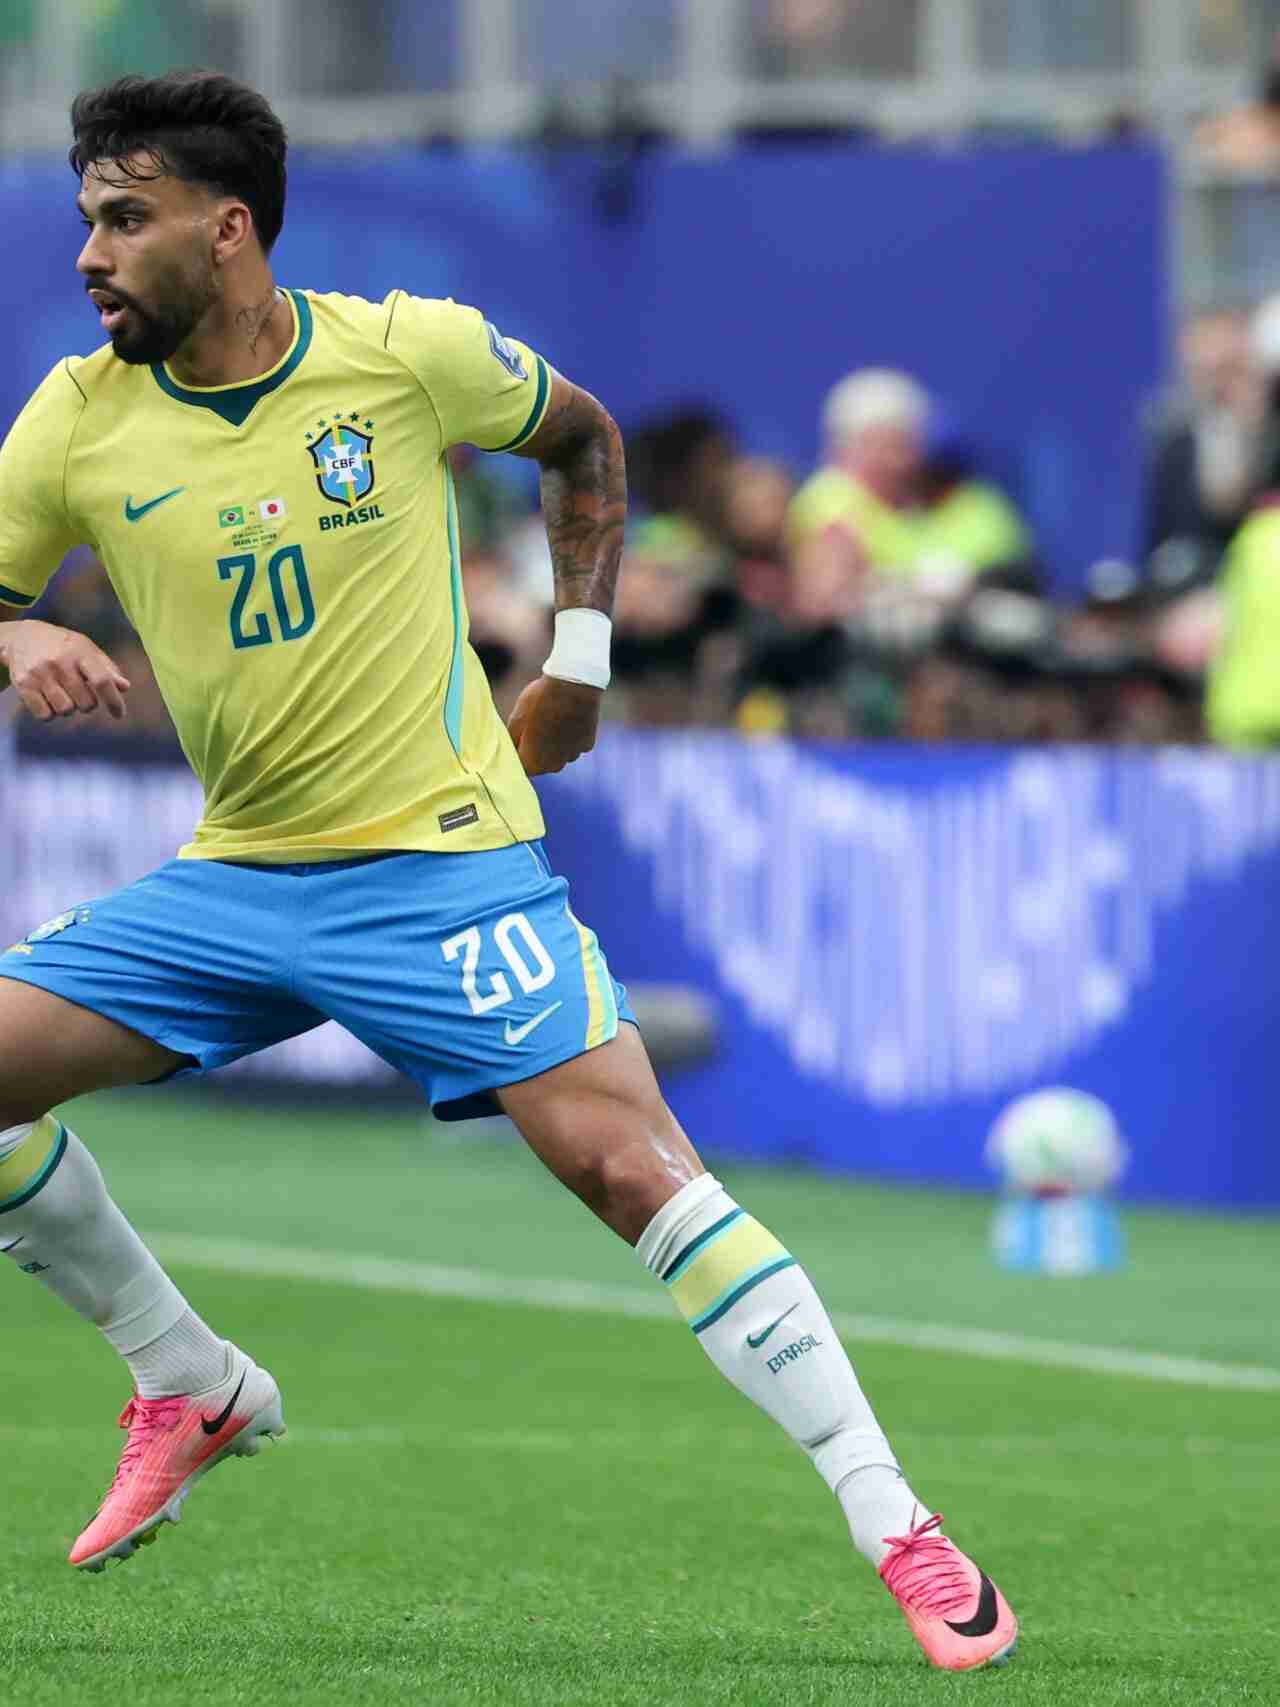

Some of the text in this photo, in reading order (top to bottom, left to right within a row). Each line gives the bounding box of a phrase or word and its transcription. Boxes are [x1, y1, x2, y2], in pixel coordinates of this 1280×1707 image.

[331, 458, 356, 469] CBF
[318, 505, 384, 531] BRASIL
[217, 544, 316, 649] 20
[440, 912, 556, 1015] 20
[766, 1334, 823, 1375] BRASIL
